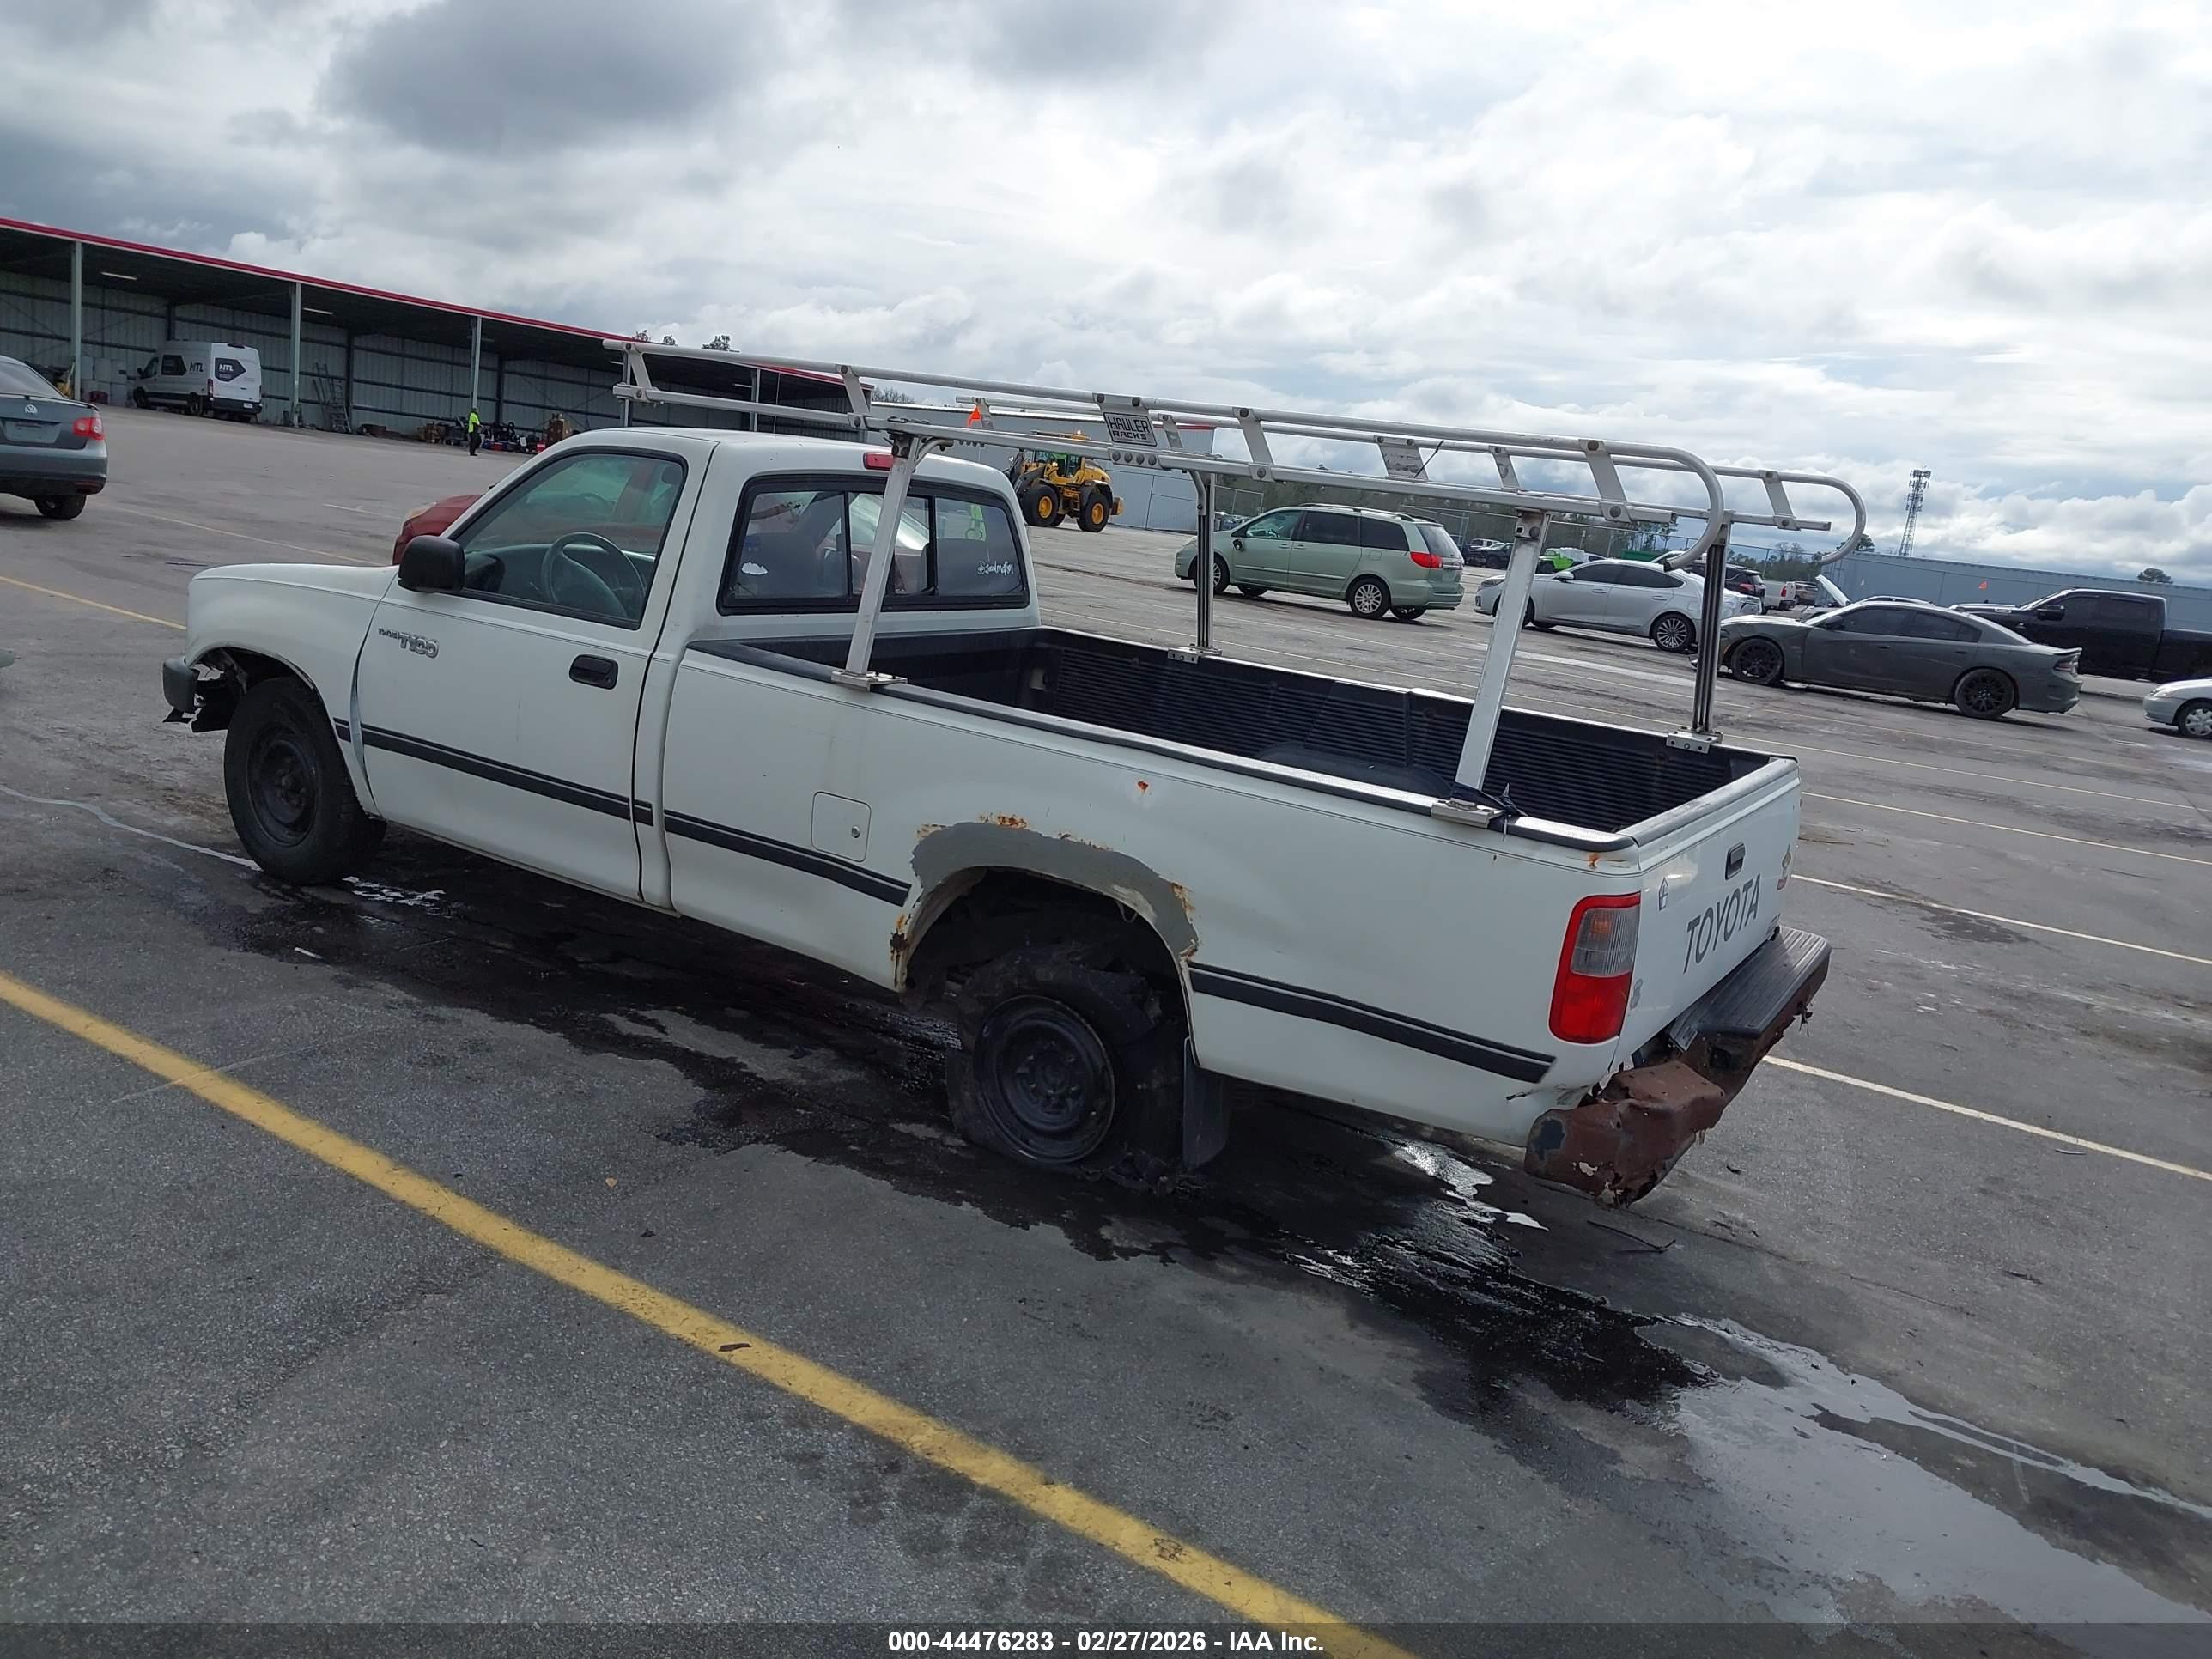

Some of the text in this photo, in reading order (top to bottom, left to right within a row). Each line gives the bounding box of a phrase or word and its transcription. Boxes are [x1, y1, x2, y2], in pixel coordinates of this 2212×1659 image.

[1108, 416, 1151, 434] HAULER
[1112, 430, 1147, 440] RACKS
[1684, 873, 1760, 974] TOYOTA
